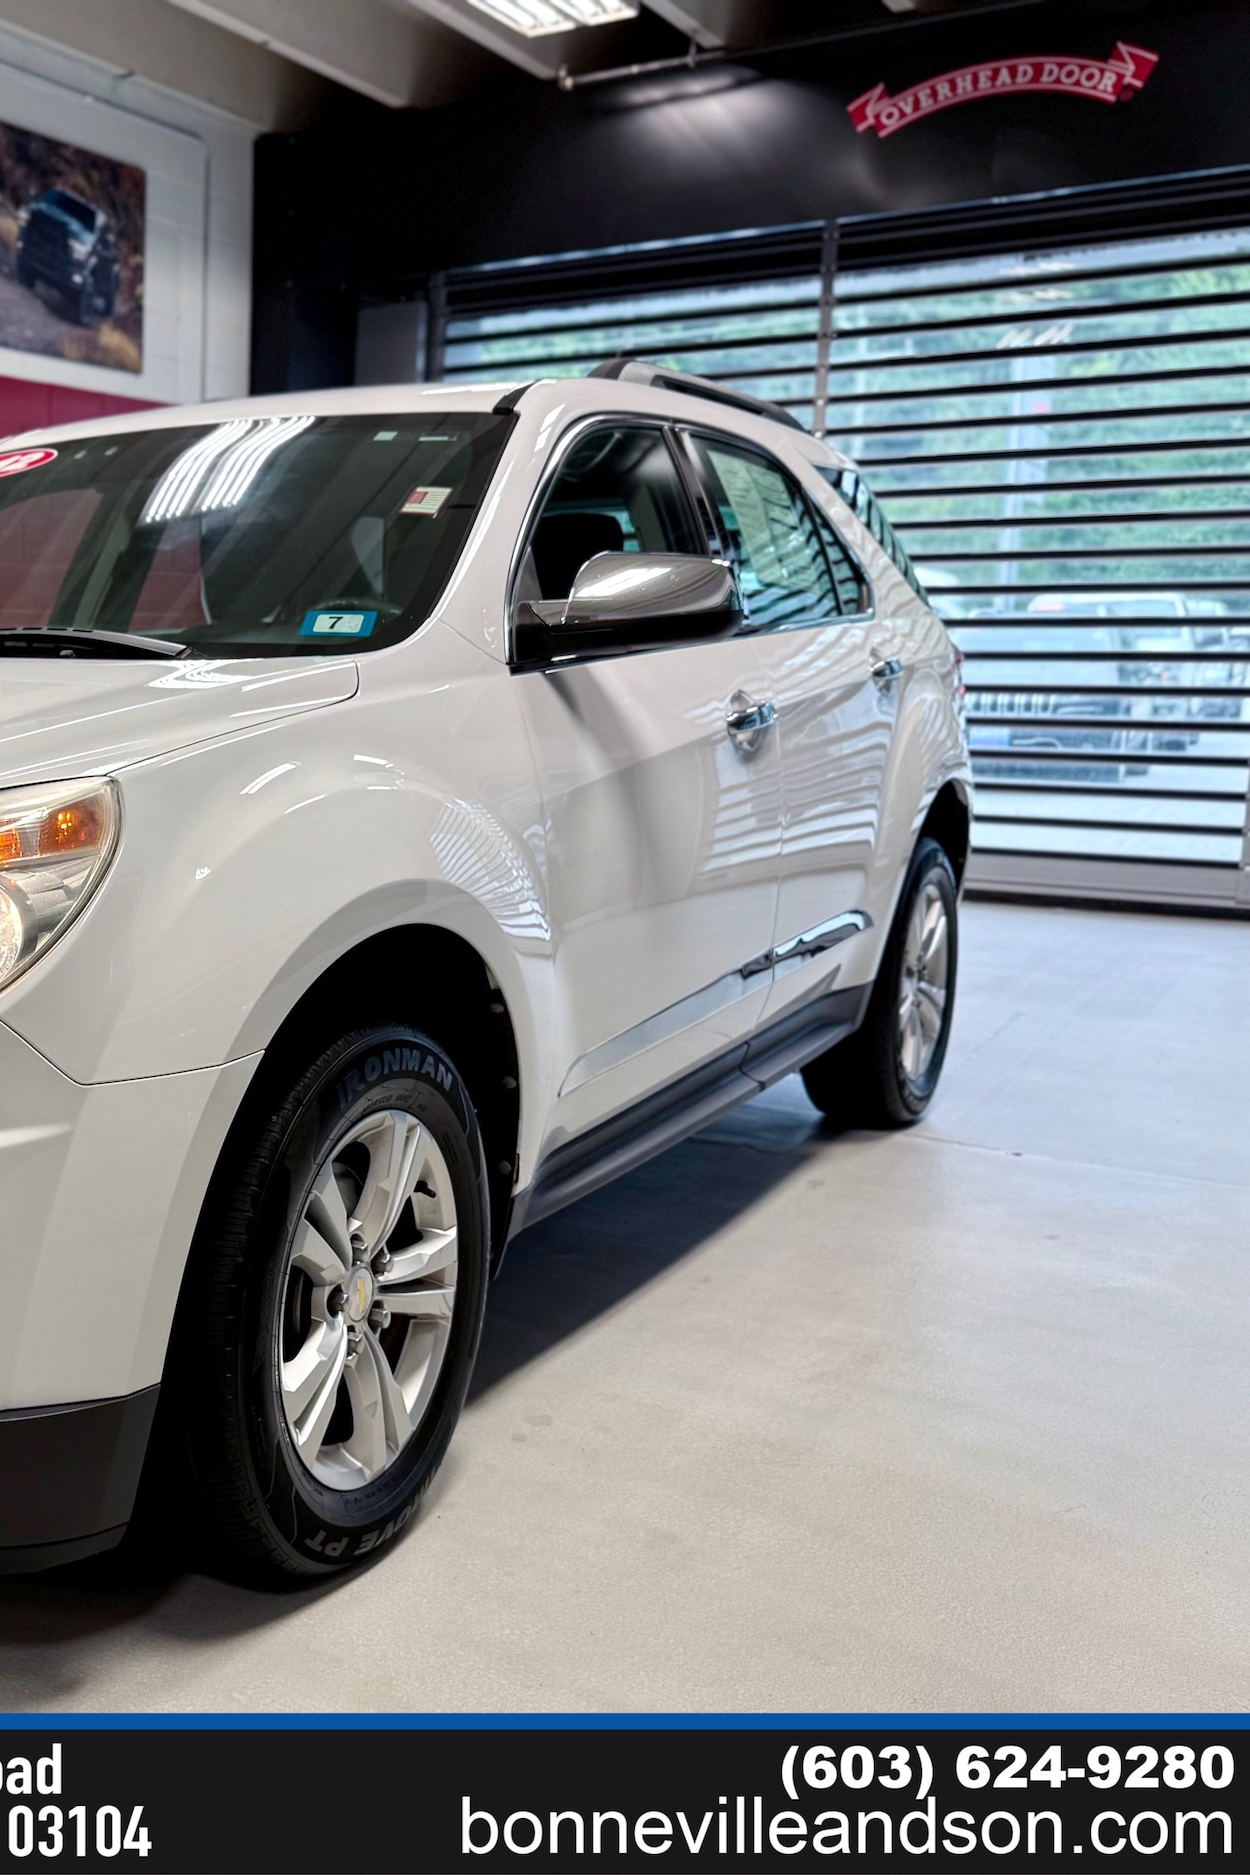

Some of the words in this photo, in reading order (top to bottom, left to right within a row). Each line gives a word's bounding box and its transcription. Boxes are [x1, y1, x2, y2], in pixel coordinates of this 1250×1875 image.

[880, 64, 1033, 126] OVERHEAD
[1042, 63, 1117, 93] DOOR
[328, 616, 343, 630] 7
[337, 1047, 453, 1111] IRONMAN
